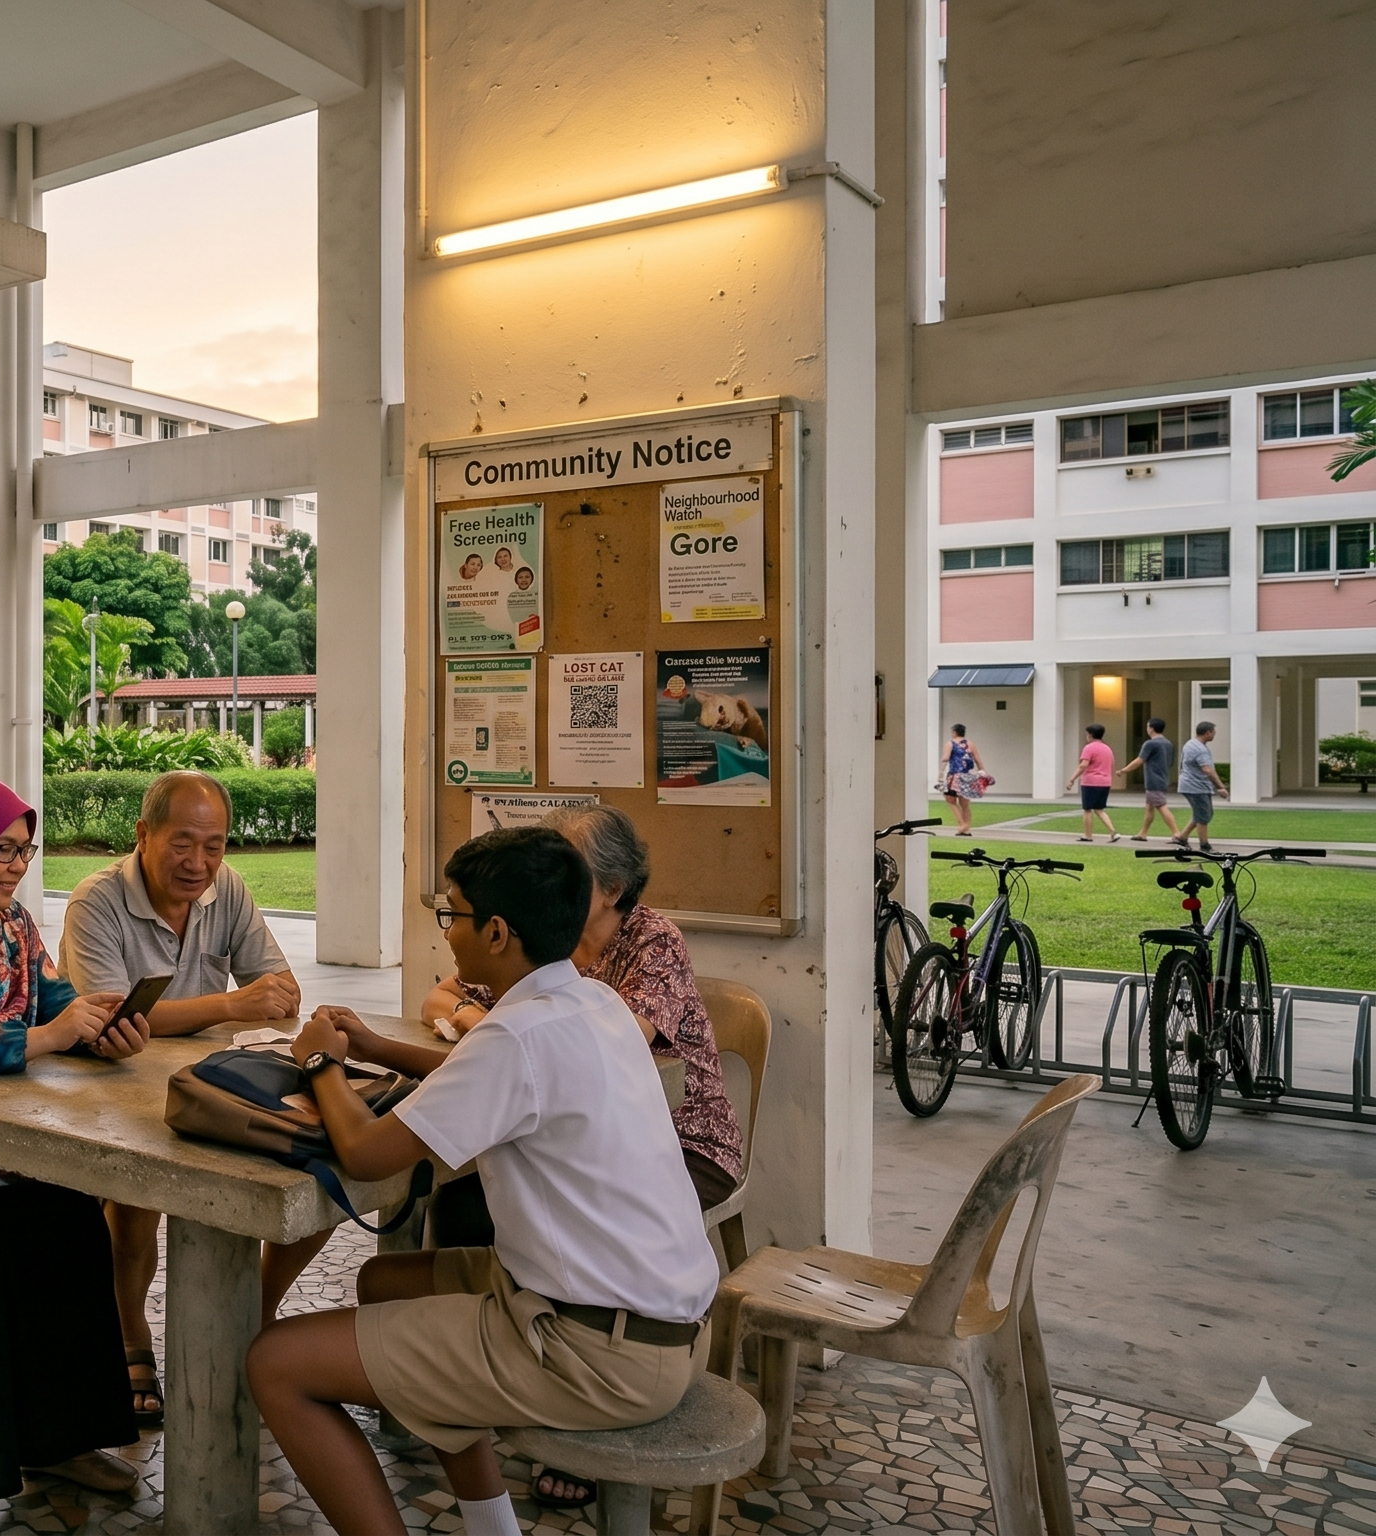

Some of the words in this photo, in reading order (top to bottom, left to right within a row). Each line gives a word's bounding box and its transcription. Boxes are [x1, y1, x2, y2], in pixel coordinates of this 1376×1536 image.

[464, 446, 622, 487] Community
[632, 434, 732, 469] Notice
[664, 487, 760, 510] Neighbourhood
[449, 519, 481, 532] Free
[485, 512, 535, 529] Health
[664, 508, 702, 522] Watch
[453, 530, 527, 547] Screening
[670, 532, 739, 556] Gore
[564, 662, 596, 673] LOST
[600, 662, 624, 673] CAT
